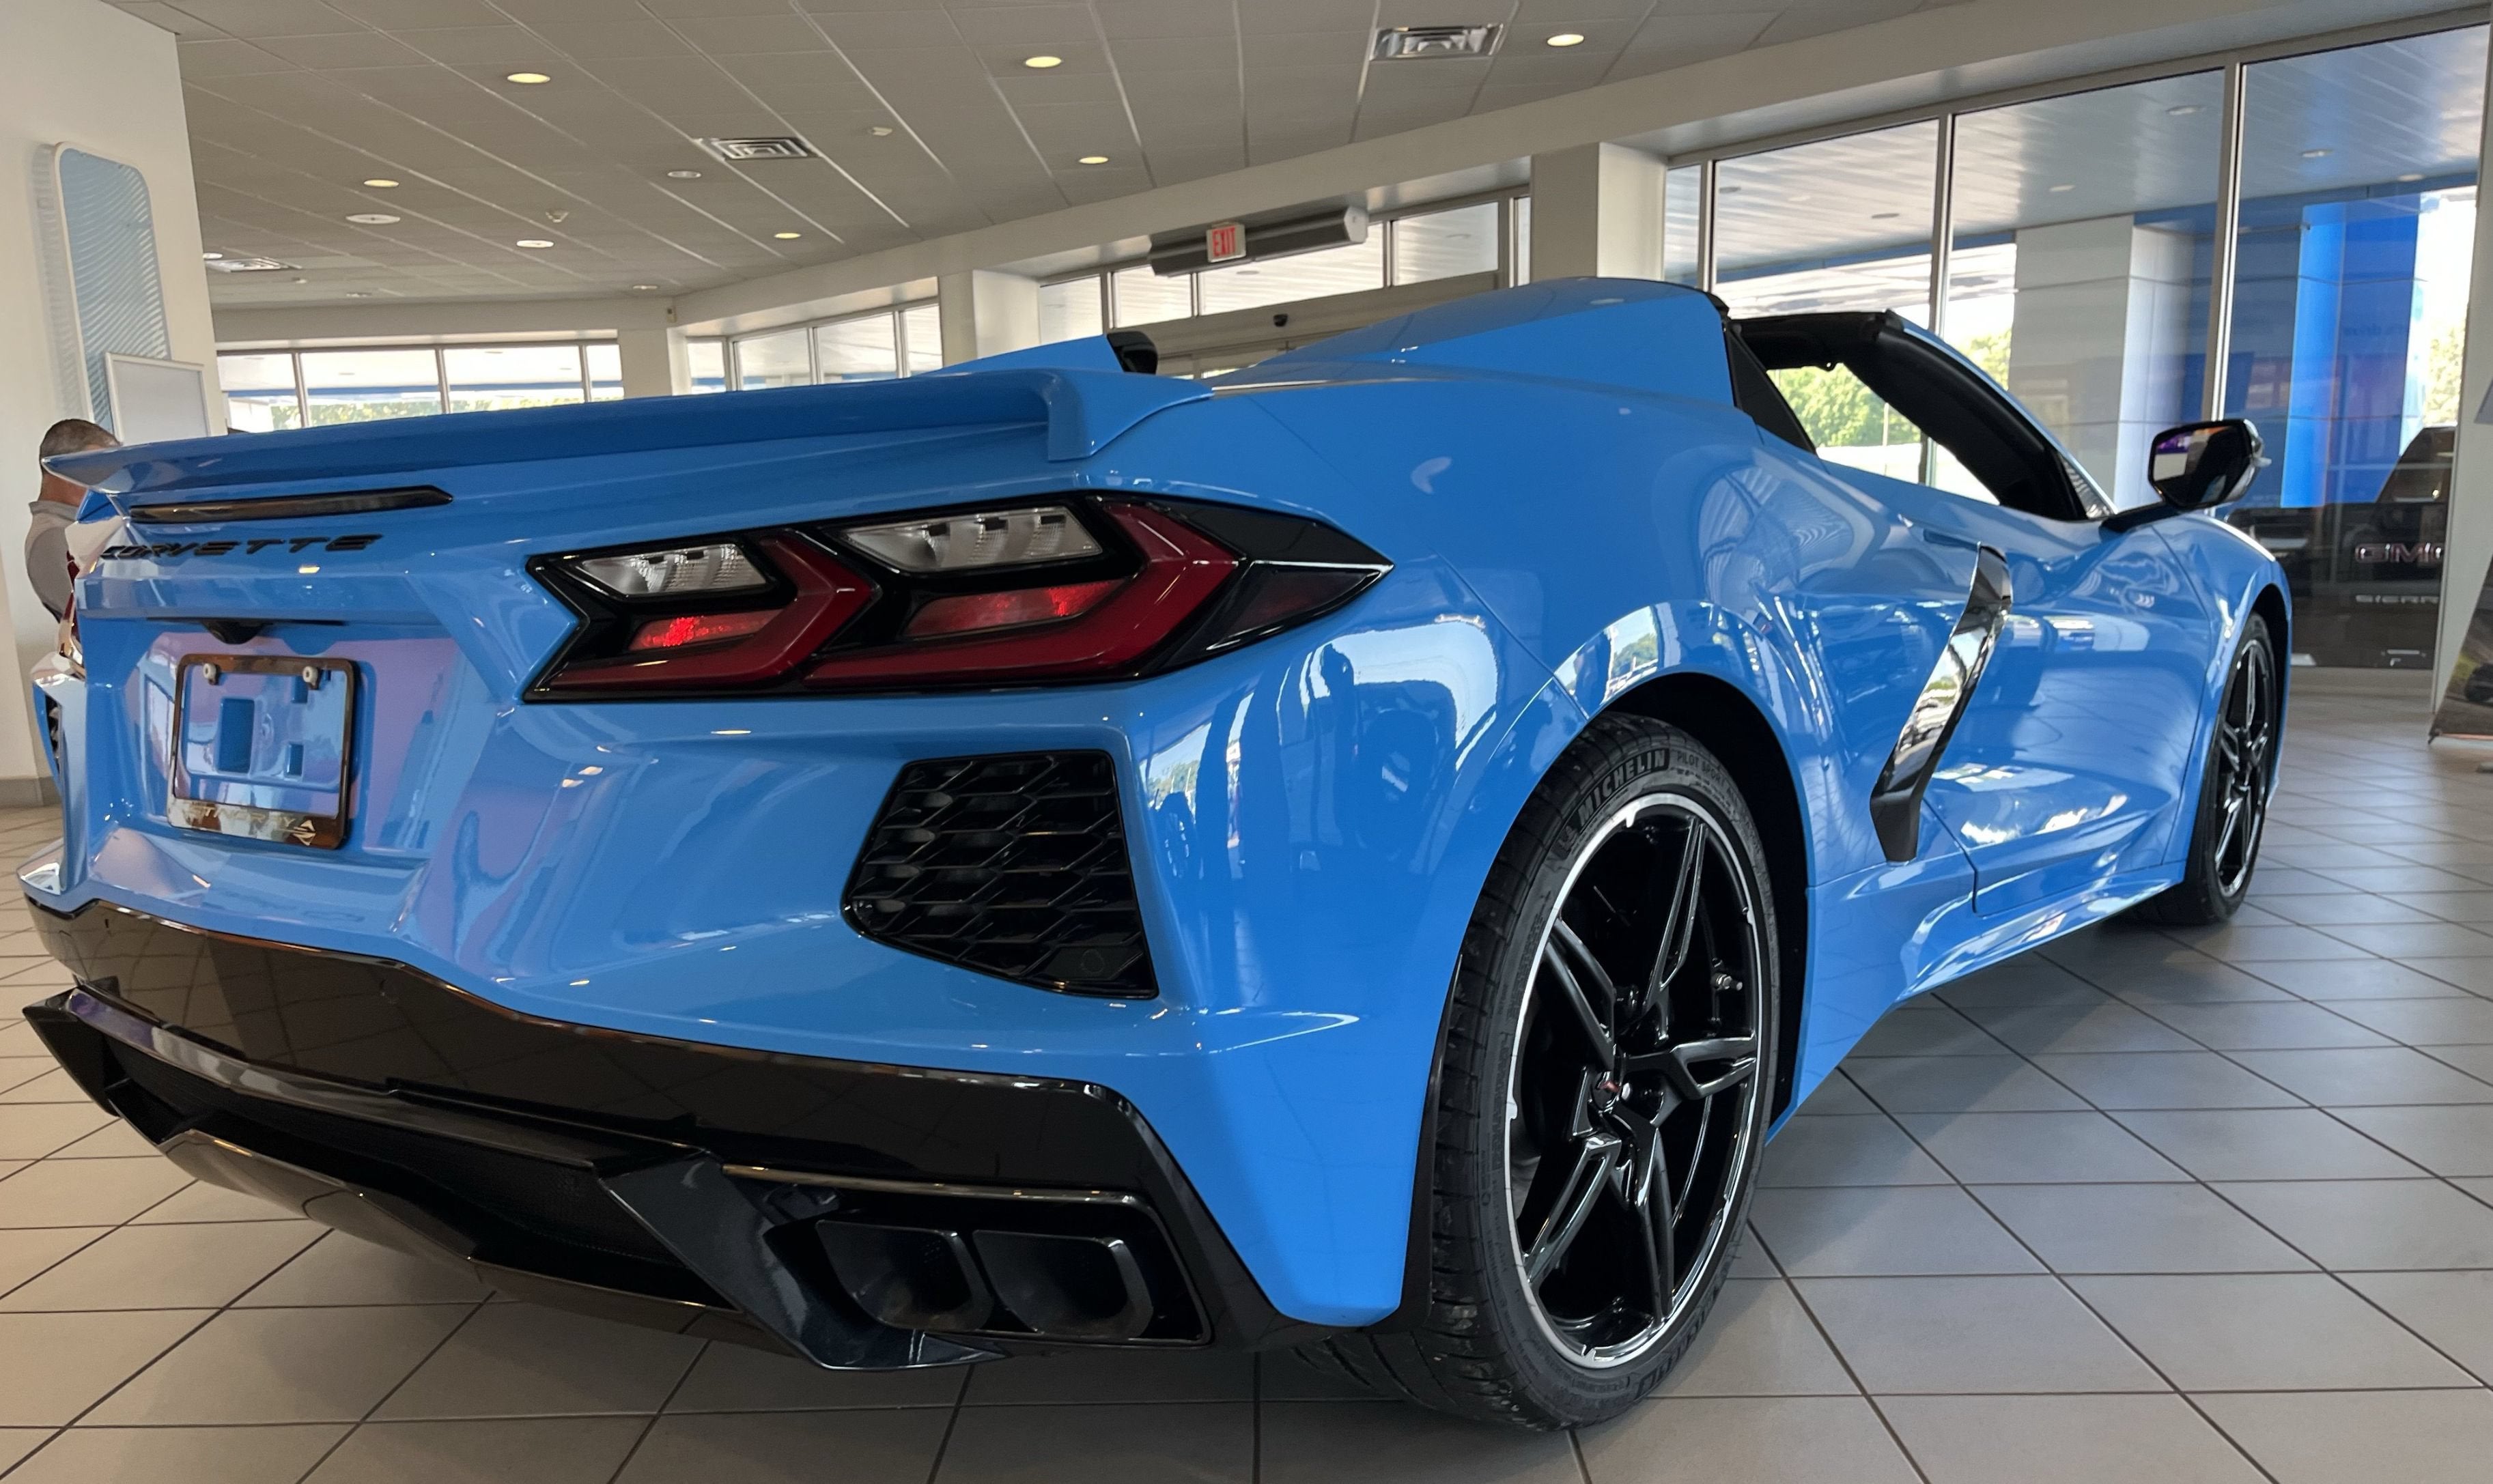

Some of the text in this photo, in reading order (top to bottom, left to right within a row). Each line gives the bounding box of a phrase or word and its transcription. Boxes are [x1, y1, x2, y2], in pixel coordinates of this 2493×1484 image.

[1212, 226, 1235, 257] EXIT
[100, 534, 383, 559] CORVETTE
[2356, 595, 2440, 604] SIERR
[1578, 751, 1665, 827] MICHELIN
[1677, 752, 1699, 768] PILOT
